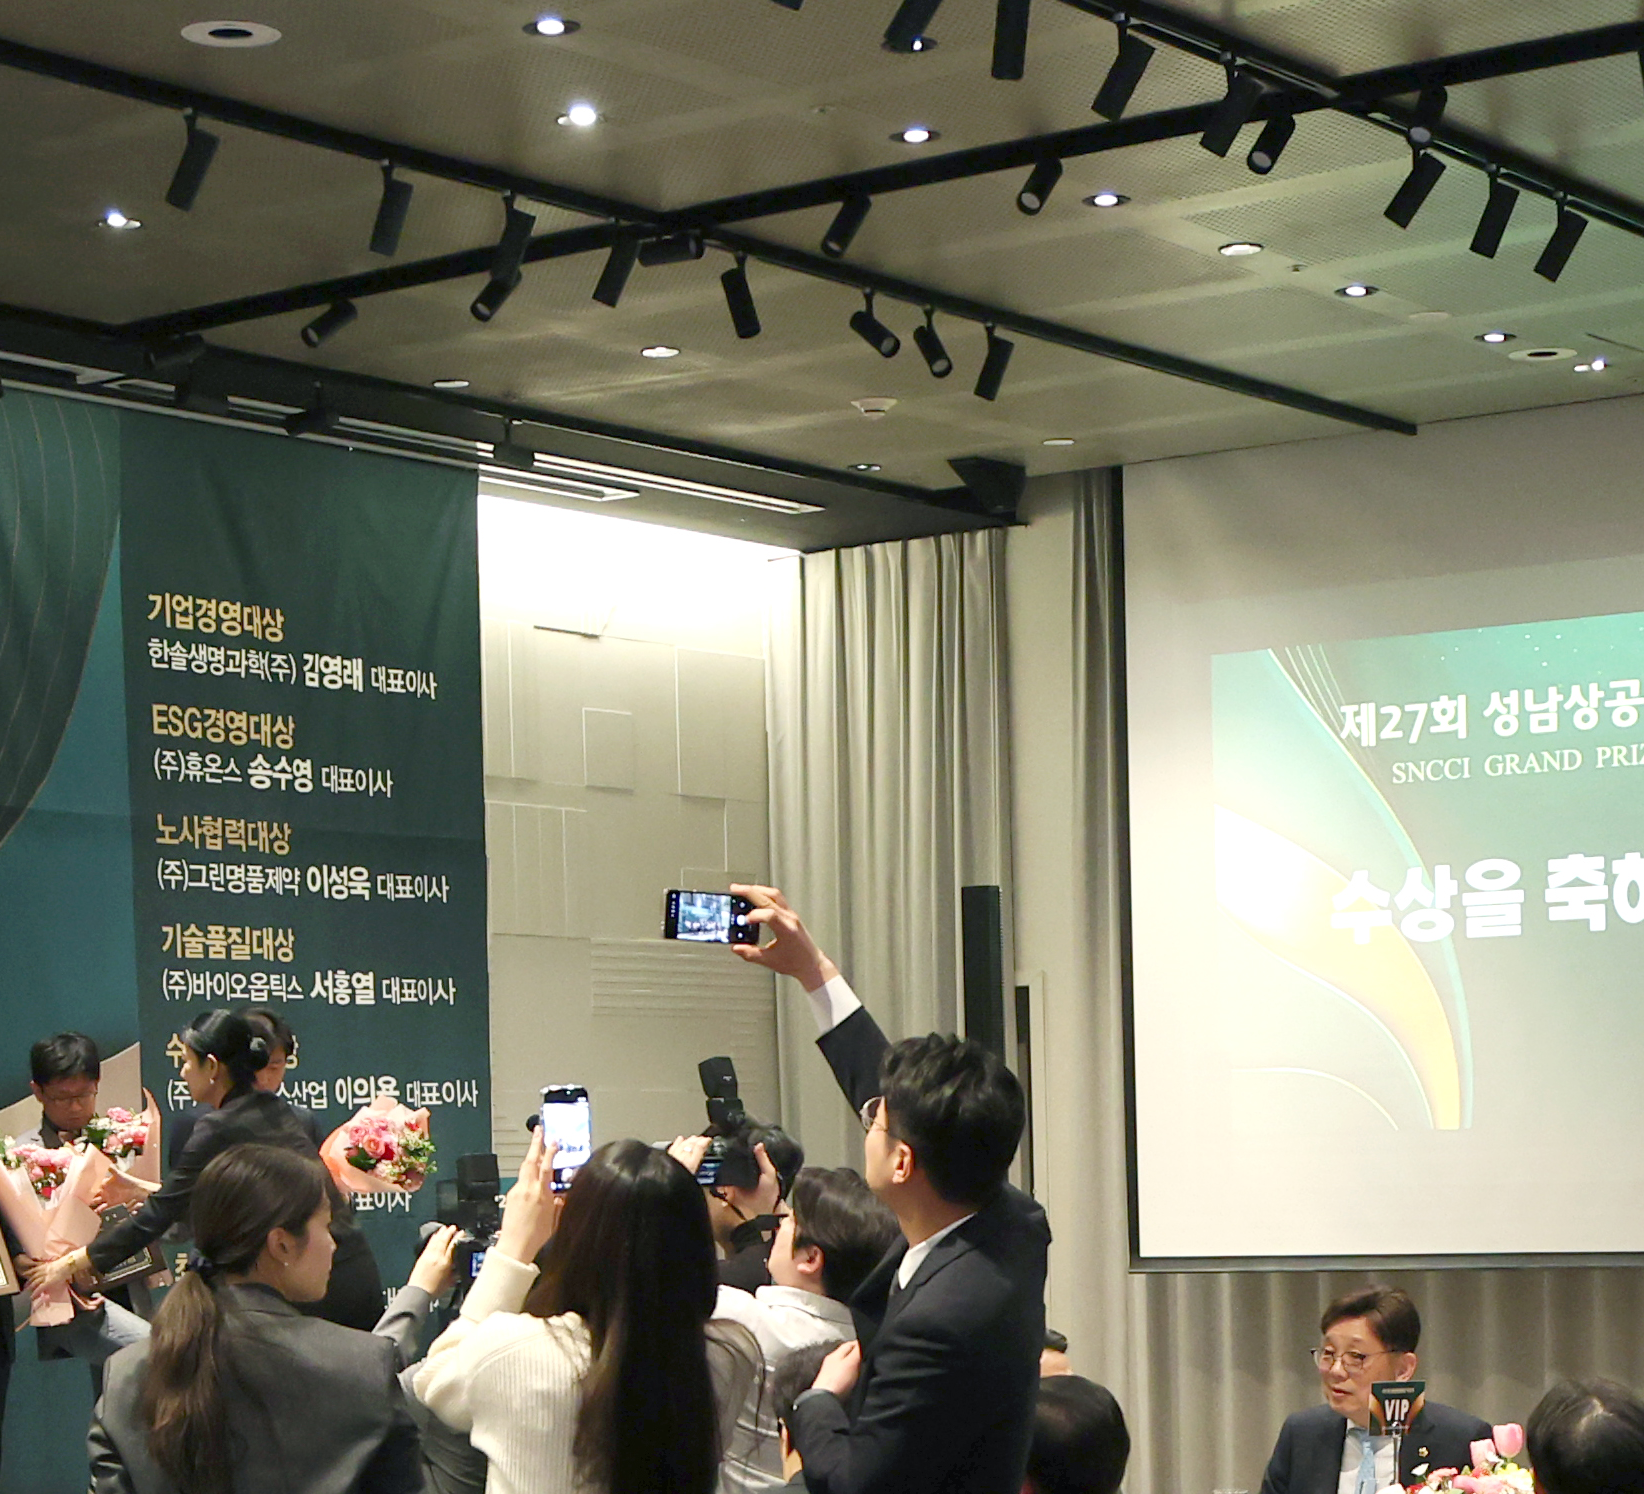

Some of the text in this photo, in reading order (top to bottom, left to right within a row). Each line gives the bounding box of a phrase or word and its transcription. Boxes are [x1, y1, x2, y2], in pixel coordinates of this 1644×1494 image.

[148, 592, 284, 643] 기업경영대상
[148, 638, 437, 699] 한솔생명과학(주) 김영래 대표이사
[152, 704, 295, 749] ESG경영대상
[1340, 694, 1468, 747] 제27회
[154, 747, 393, 798] (주)휴온스 송수영 대표이사
[1392, 756, 1471, 784] SNCCI
[1484, 749, 1582, 777] GRAND
[156, 813, 292, 855] 노사협력대상
[157, 858, 449, 903] (주)그린명품제약 이성욱 대표이사
[1331, 859, 1524, 943] 수상을
[161, 923, 294, 963] 기술품질대상
[162, 968, 456, 1005] (주)바이오옵틱스 서홍열 대표이사
[406, 1079, 478, 1108] 대표이사
[1385, 1398, 1410, 1421] VIP
